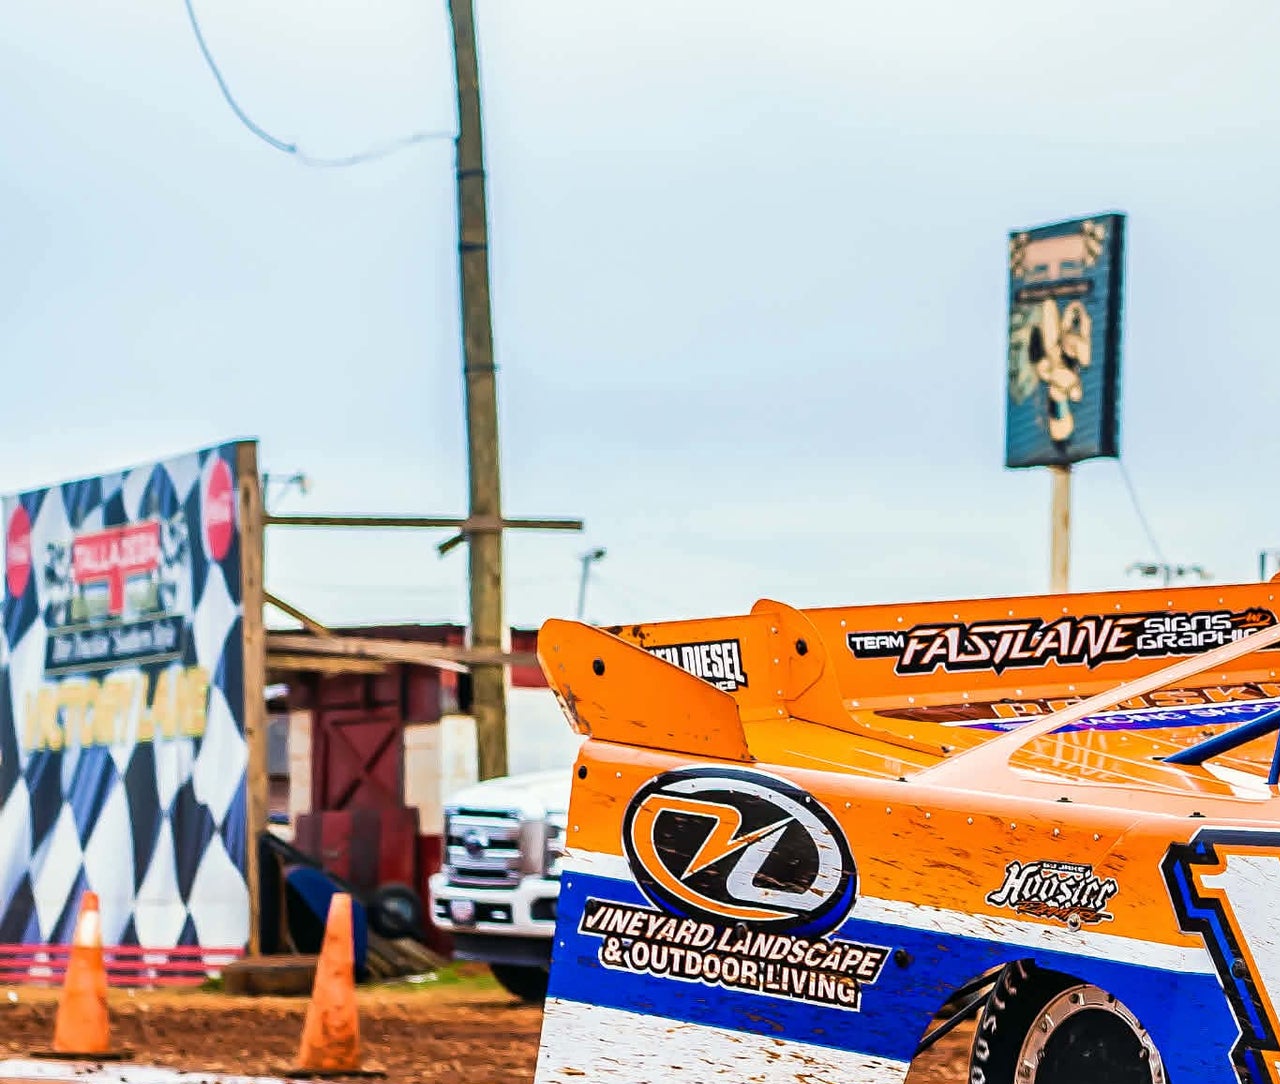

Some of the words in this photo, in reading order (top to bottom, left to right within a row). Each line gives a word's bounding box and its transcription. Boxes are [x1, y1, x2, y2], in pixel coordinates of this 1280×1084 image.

[851, 632, 905, 652] TEAM
[901, 617, 1149, 667] FASTLANE
[1143, 614, 1232, 634] SIGNS
[681, 642, 745, 683] DIESEL
[1080, 708, 1187, 729] ACING
[988, 862, 1117, 908] Hoosier
[586, 905, 715, 949] VINEYARD
[716, 929, 882, 978] LANDSCAPE
[603, 937, 623, 963] &
[631, 941, 759, 987] OUTDOOR
[765, 966, 857, 1004] LIVING
